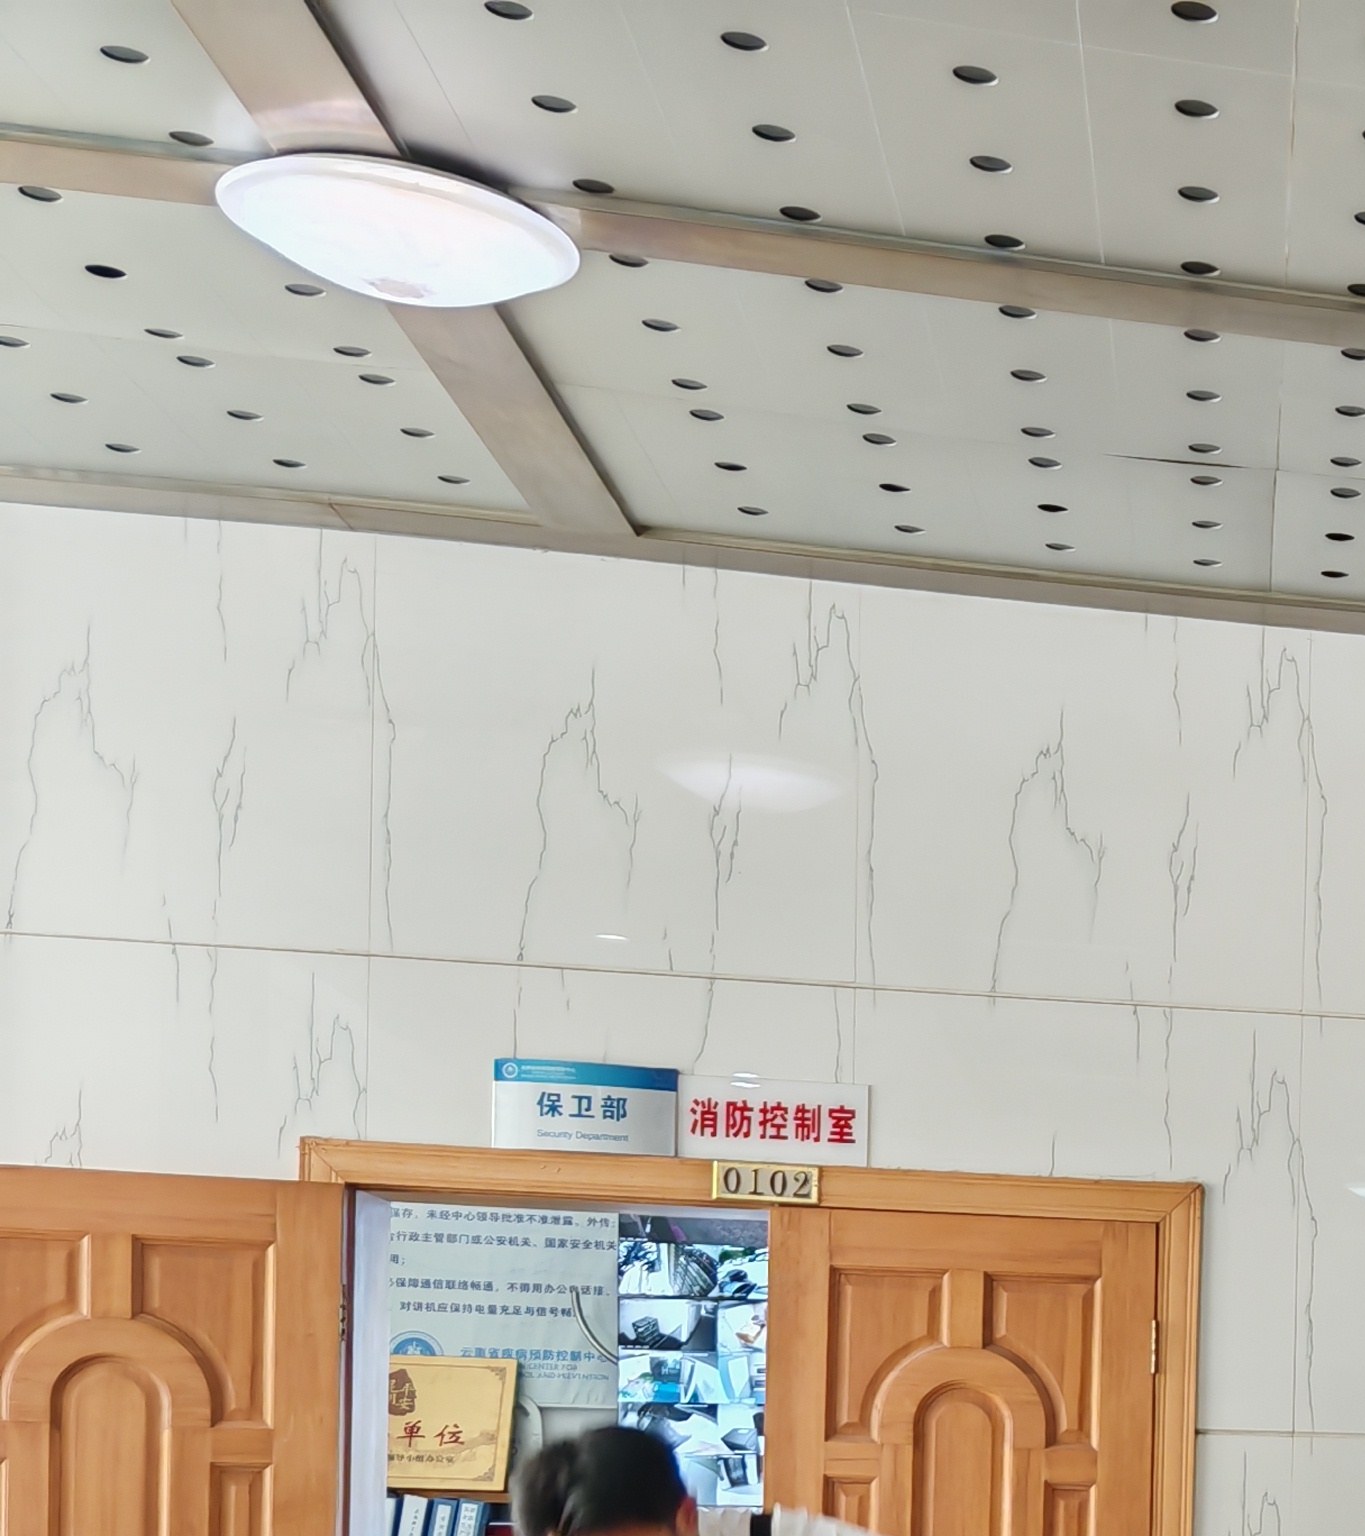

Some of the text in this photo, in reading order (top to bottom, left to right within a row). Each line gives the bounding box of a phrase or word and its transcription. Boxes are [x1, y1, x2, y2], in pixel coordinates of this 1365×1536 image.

[537, 1091, 628, 1122] 保卫部
[690, 1097, 857, 1144] 消防控制室
[537, 1128, 629, 1143] Security Department
[722, 1166, 813, 1199] 0102
